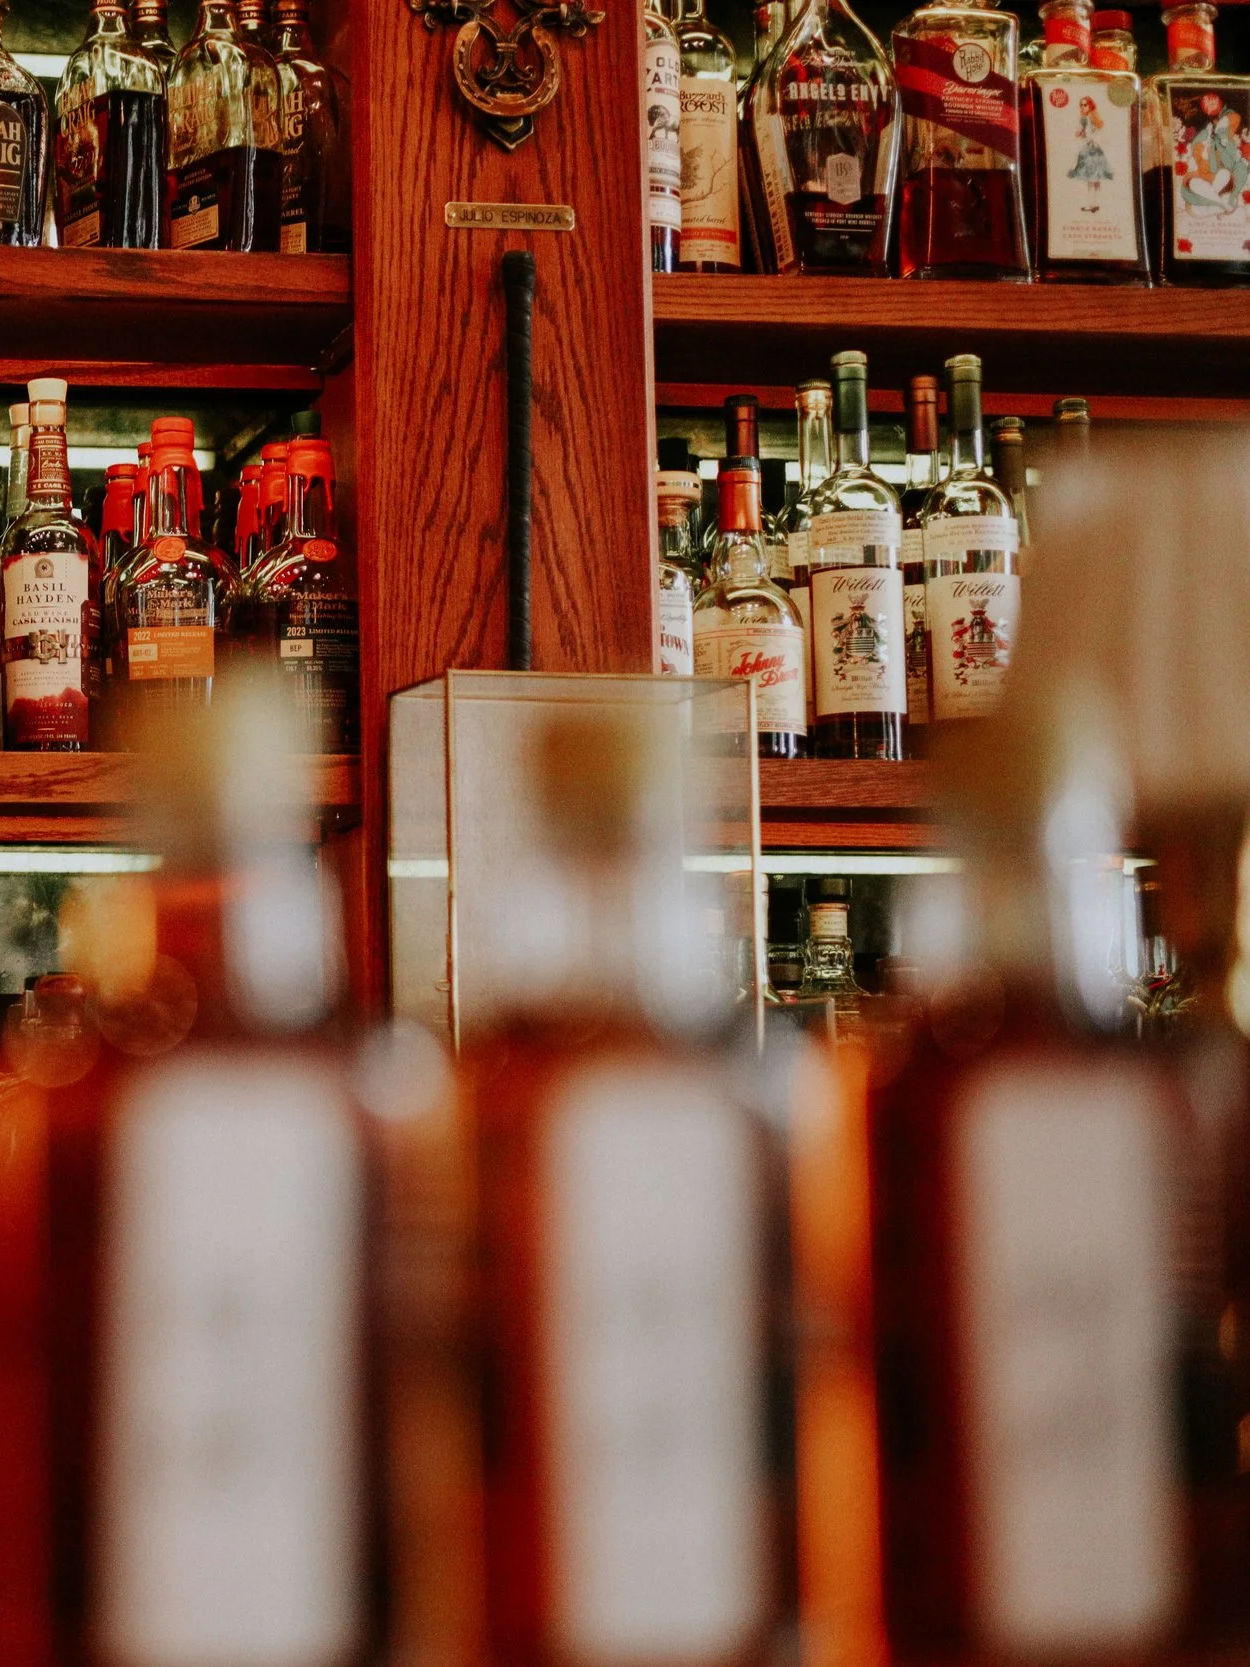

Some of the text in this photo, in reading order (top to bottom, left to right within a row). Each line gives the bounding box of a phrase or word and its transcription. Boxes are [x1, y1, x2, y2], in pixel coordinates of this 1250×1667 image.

[851, 84, 888, 111] ENVY
[281, 207, 305, 218] ARREL
[459, 208, 562, 225] JULIO ESPINOZA
[24, 583, 67, 593] BASIL
[831, 575, 886, 593] Willett
[950, 580, 1007, 598] Willett
[16, 593, 77, 605] HAYDEN
[295, 591, 348, 601] Maker's
[312, 601, 347, 610] Mark
[12, 616, 79, 626] CASK FINISH
[133, 630, 151, 642] 2022
[286, 626, 307, 637] 2023
[730, 650, 787, 677] Johnny
